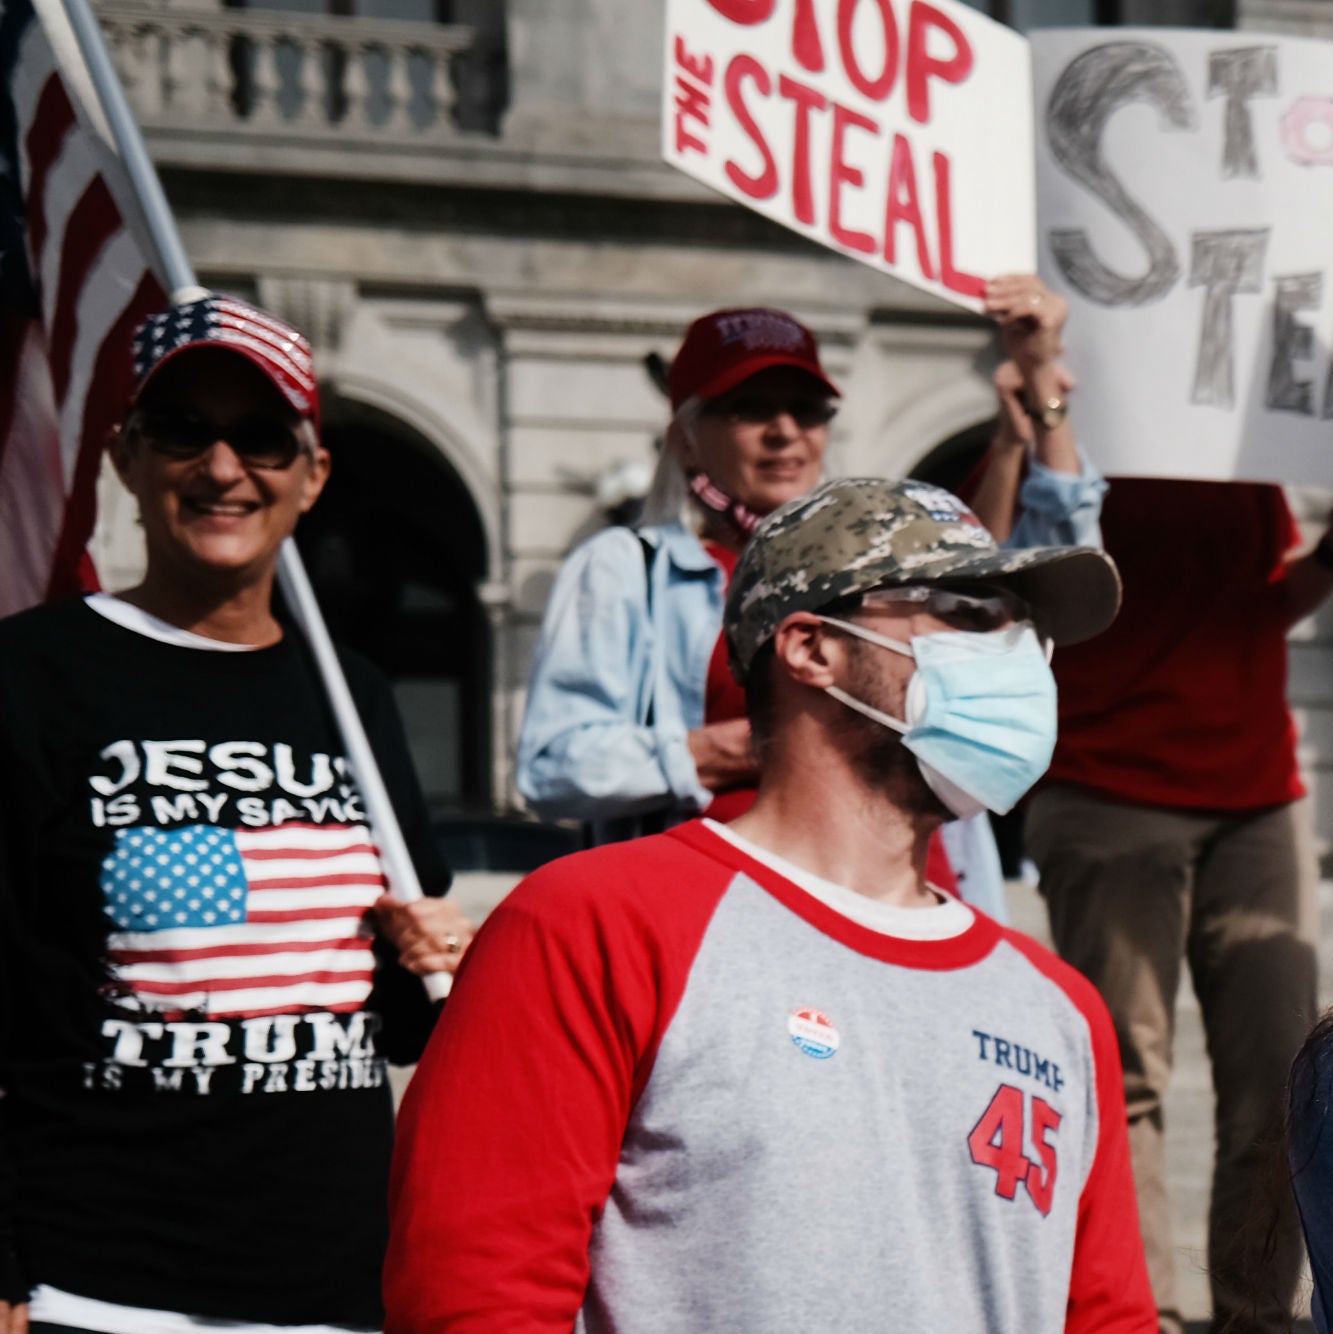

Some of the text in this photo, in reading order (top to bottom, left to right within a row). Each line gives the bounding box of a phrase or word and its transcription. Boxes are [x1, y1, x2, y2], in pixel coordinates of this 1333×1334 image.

[674, 35, 713, 155] THE
[704, 0, 974, 125] TOP
[723, 53, 987, 299] STEAL
[90, 793, 367, 827] IS MY SAVIO
[83, 1061, 123, 1091] IS
[152, 1065, 215, 1095] MY
[966, 1082, 1064, 1219] 45
